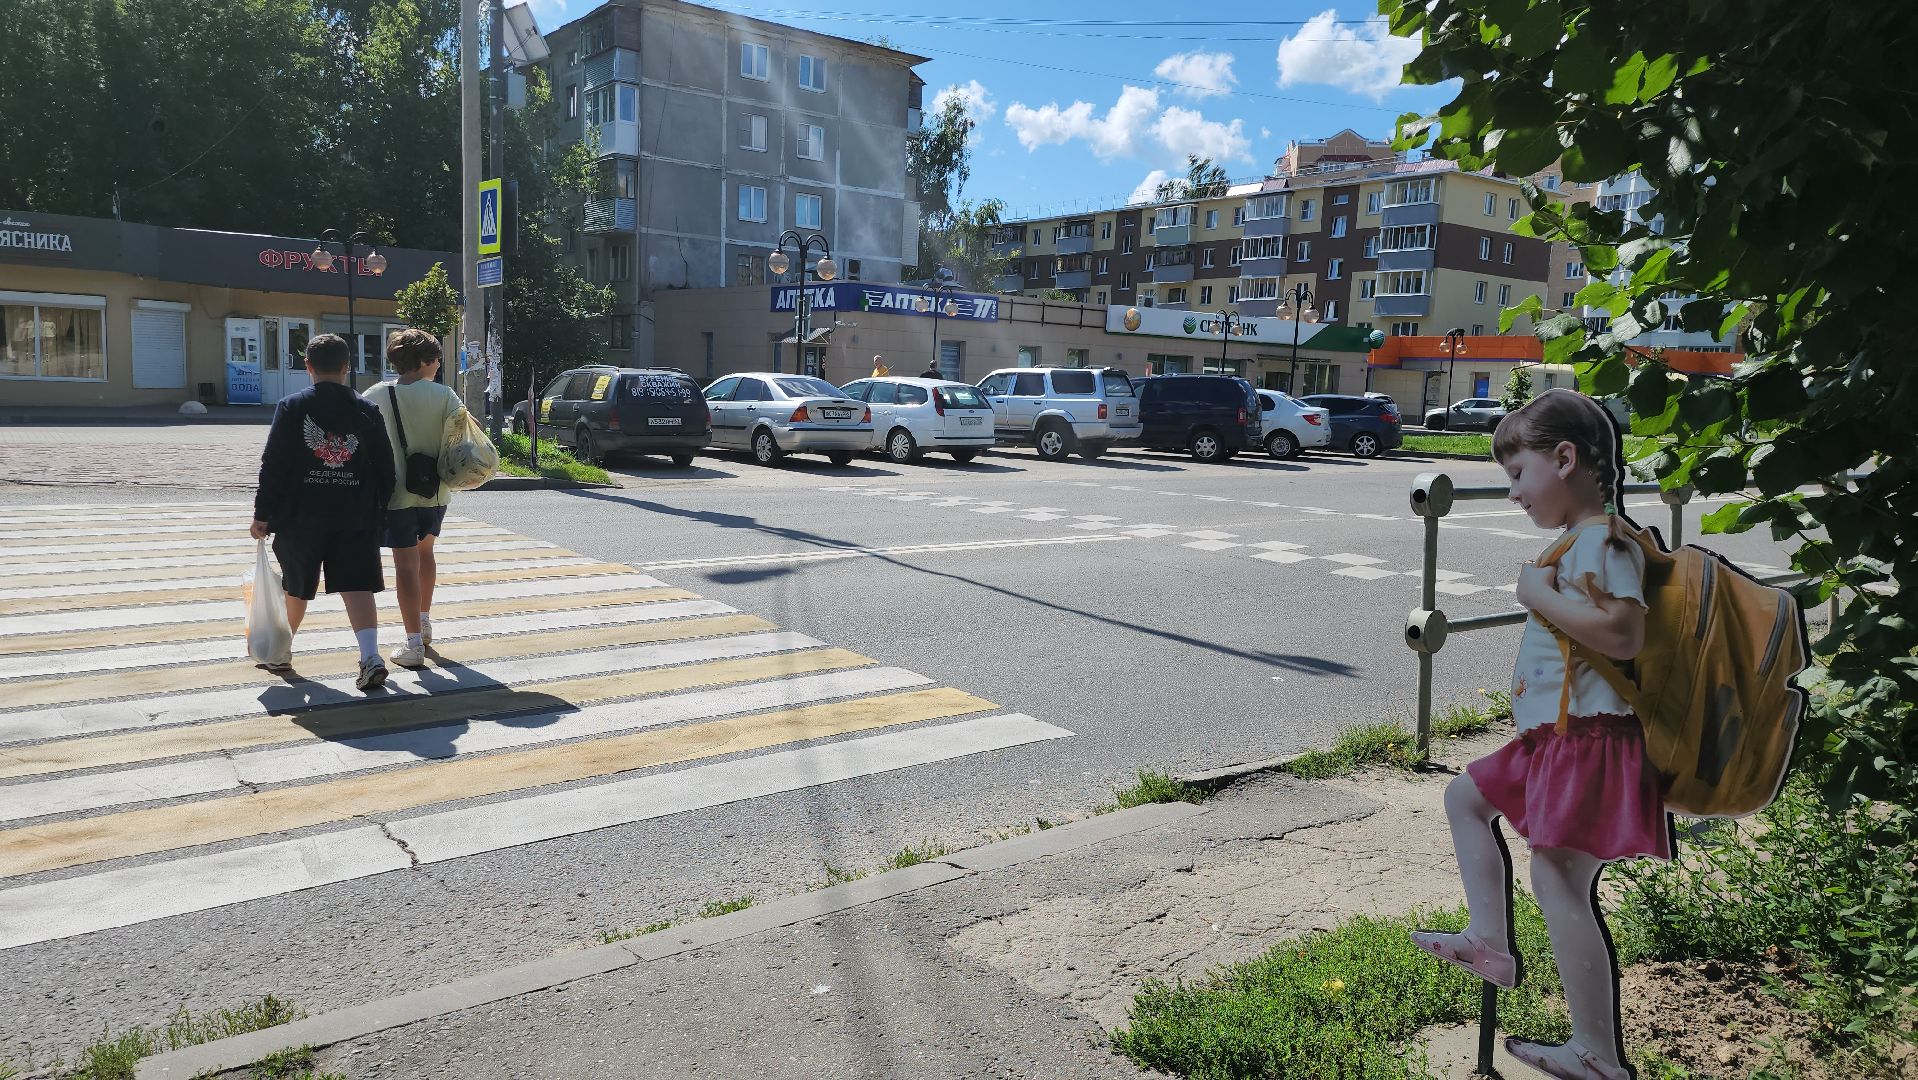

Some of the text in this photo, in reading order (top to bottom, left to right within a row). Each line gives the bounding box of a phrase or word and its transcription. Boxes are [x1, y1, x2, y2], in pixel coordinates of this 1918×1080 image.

[775, 287, 836, 309] АПКА
[880, 292, 957, 315] АПТК
[1199, 319, 1258, 337] СРБНК
[231, 383, 260, 392] ВОДА
